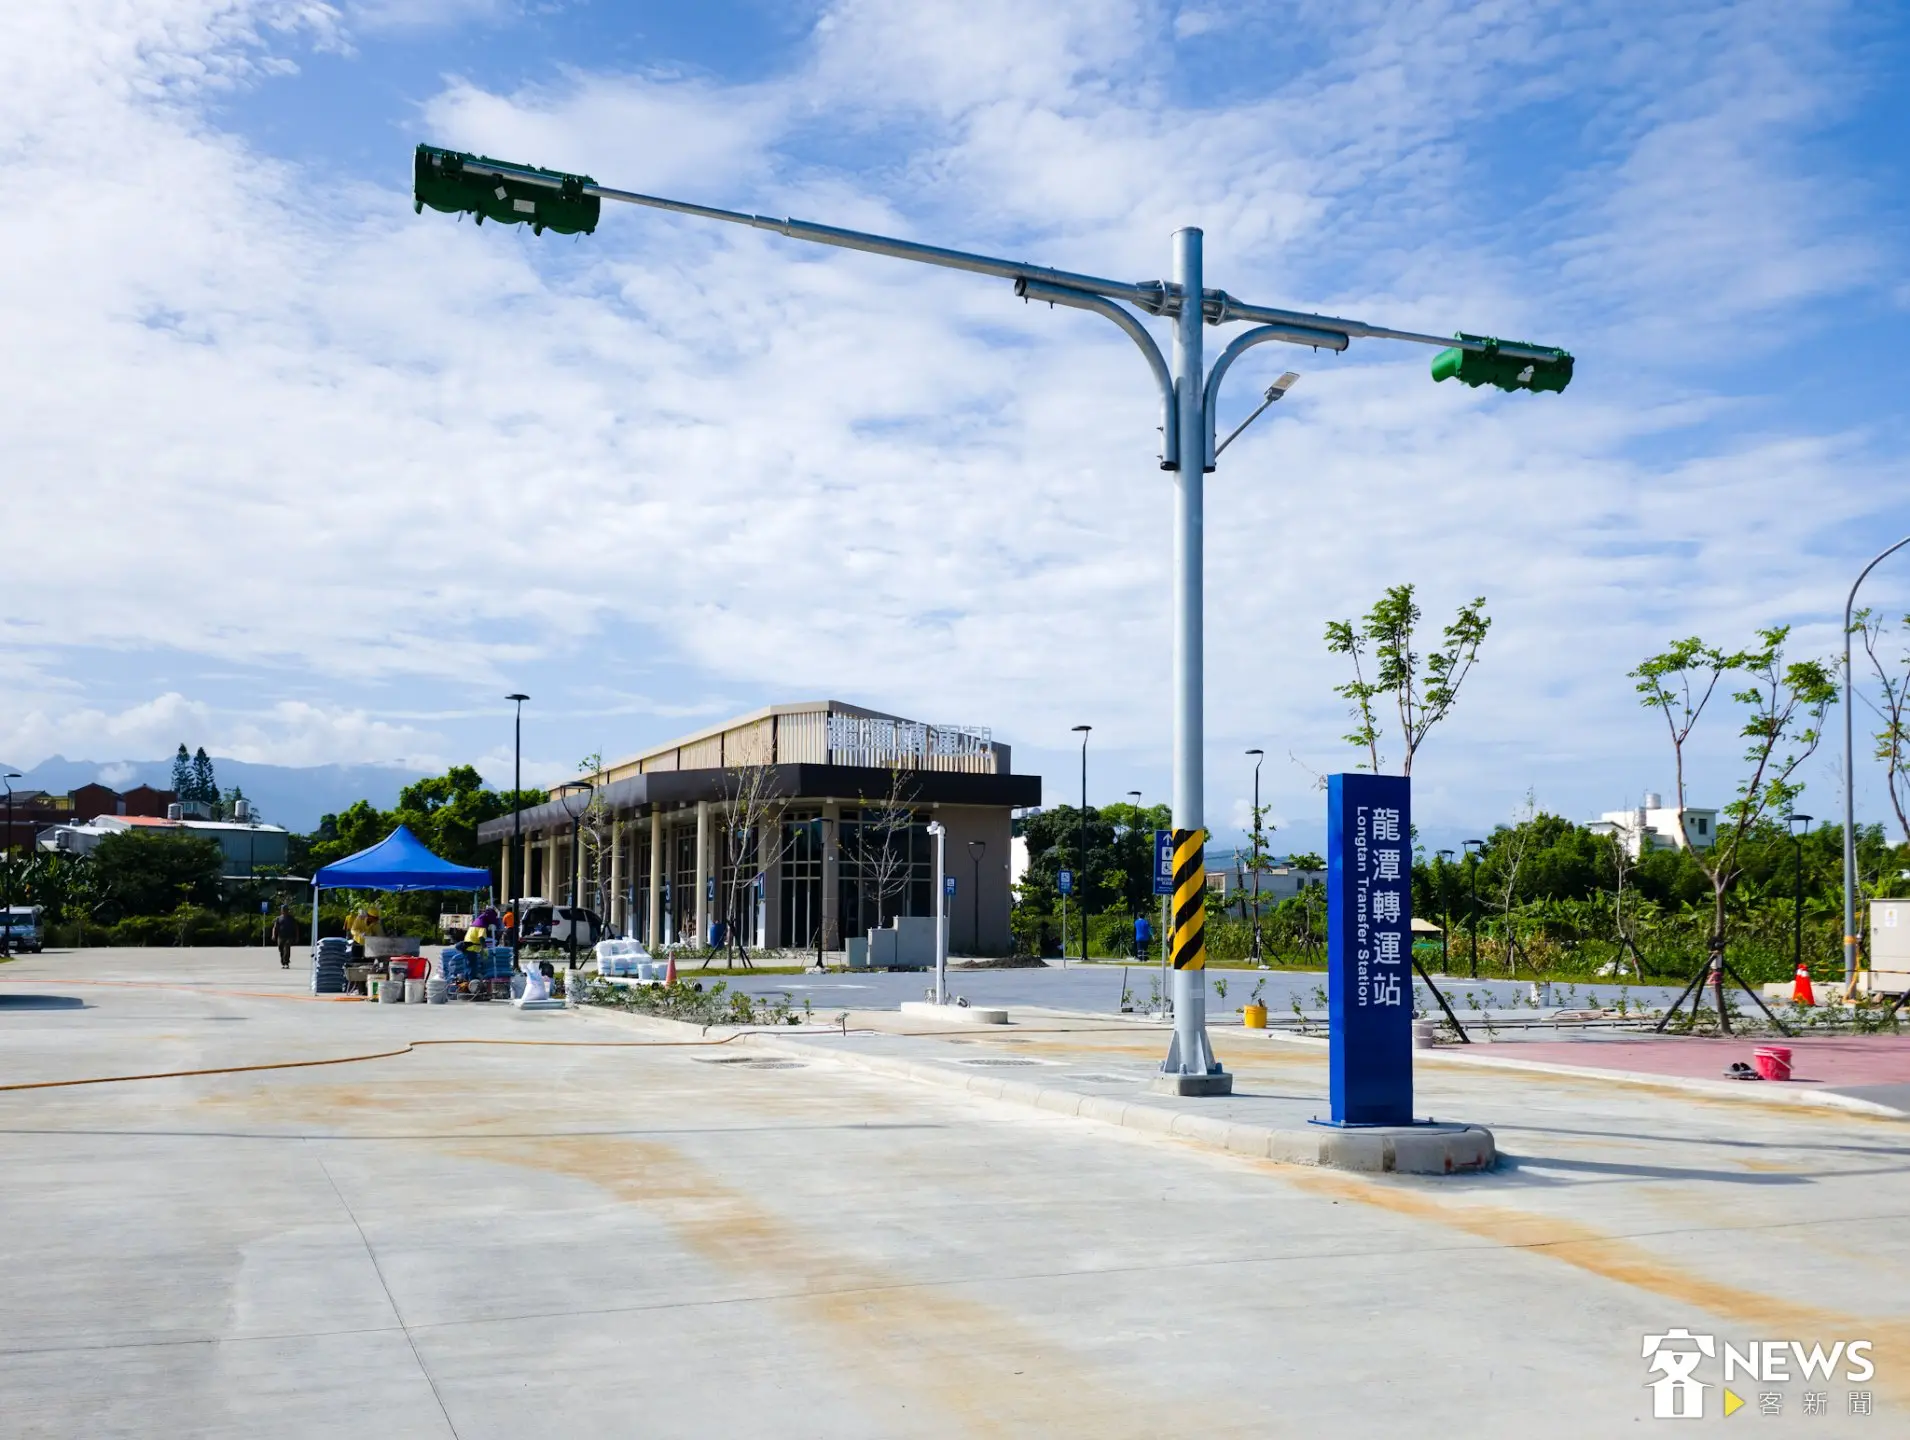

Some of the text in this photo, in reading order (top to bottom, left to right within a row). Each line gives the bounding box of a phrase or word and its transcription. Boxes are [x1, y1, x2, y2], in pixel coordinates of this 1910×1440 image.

[1354, 806, 1370, 1007] Longtan Transfer Station
[1372, 807, 1401, 1006] 龍潭轉運站
